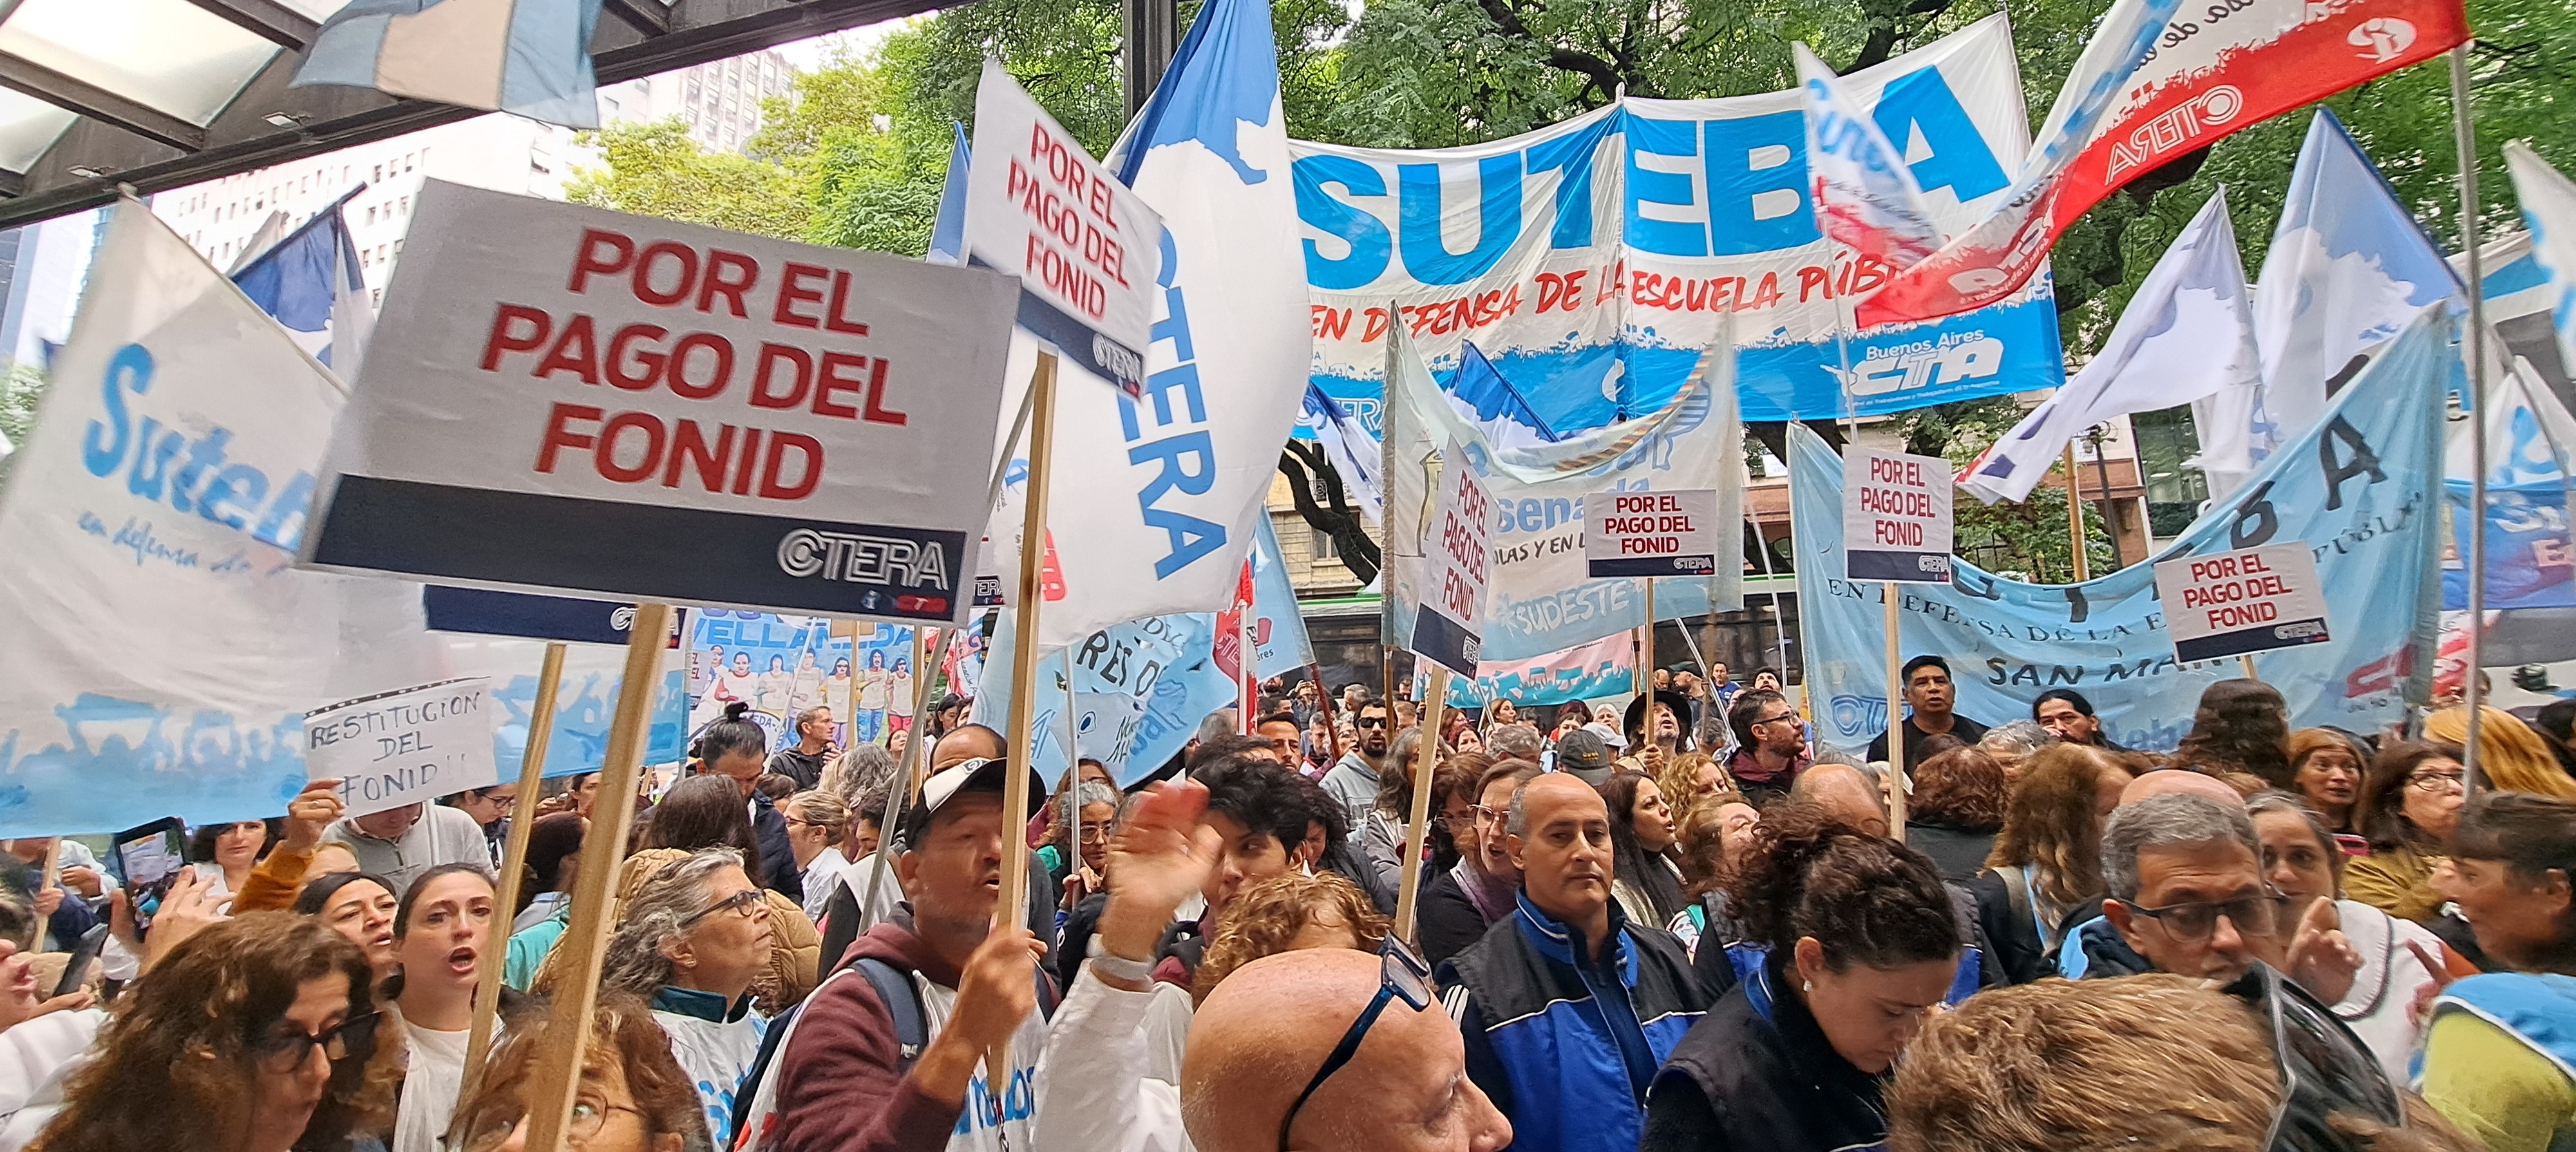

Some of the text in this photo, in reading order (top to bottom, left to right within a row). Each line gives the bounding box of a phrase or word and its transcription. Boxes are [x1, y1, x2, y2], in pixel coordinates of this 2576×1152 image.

[1030, 119, 1118, 233] POR EL
[1292, 67, 2011, 290] SUTEBA
[1007, 156, 1131, 290] PAGO DEL
[568, 225, 870, 338] POR EL
[1025, 232, 1106, 320] FONID
[1535, 269, 1588, 314] DE
[1596, 259, 1626, 306] LA
[1632, 270, 1786, 312] ESCUELA
[480, 302, 907, 427] PAGO DEL
[1848, 336, 2005, 397] CTA
[1866, 328, 1985, 361] Buenos Aires
[533, 401, 824, 501] FONID
[1871, 457, 1925, 487] POR EL
[1457, 469, 1488, 538] POR EL
[1605, 516, 1695, 534] PAGO DEL
[1616, 495, 1682, 513] POR EL
[1861, 487, 1936, 518] PAGO DEL
[1442, 509, 1484, 587] PAGO DEL
[1533, 540, 1546, 557] Y
[1549, 534, 1573, 554] EN
[1621, 536, 1679, 554] FONID
[1875, 520, 1924, 546] FONID
[777, 527, 949, 591] CTERA
[2190, 553, 2270, 583] POR EL
[1443, 565, 1474, 622] FONID
[1828, 579, 1868, 601] EN
[2027, 626, 2075, 642] DE
[2088, 624, 2132, 642] LA
[2183, 574, 2293, 609] PAGO DEL
[2207, 601, 2278, 630] FONID
[1986, 658, 2086, 686] SAN
[372, 730, 433, 762] DEL
[339, 763, 438, 806] FONID
